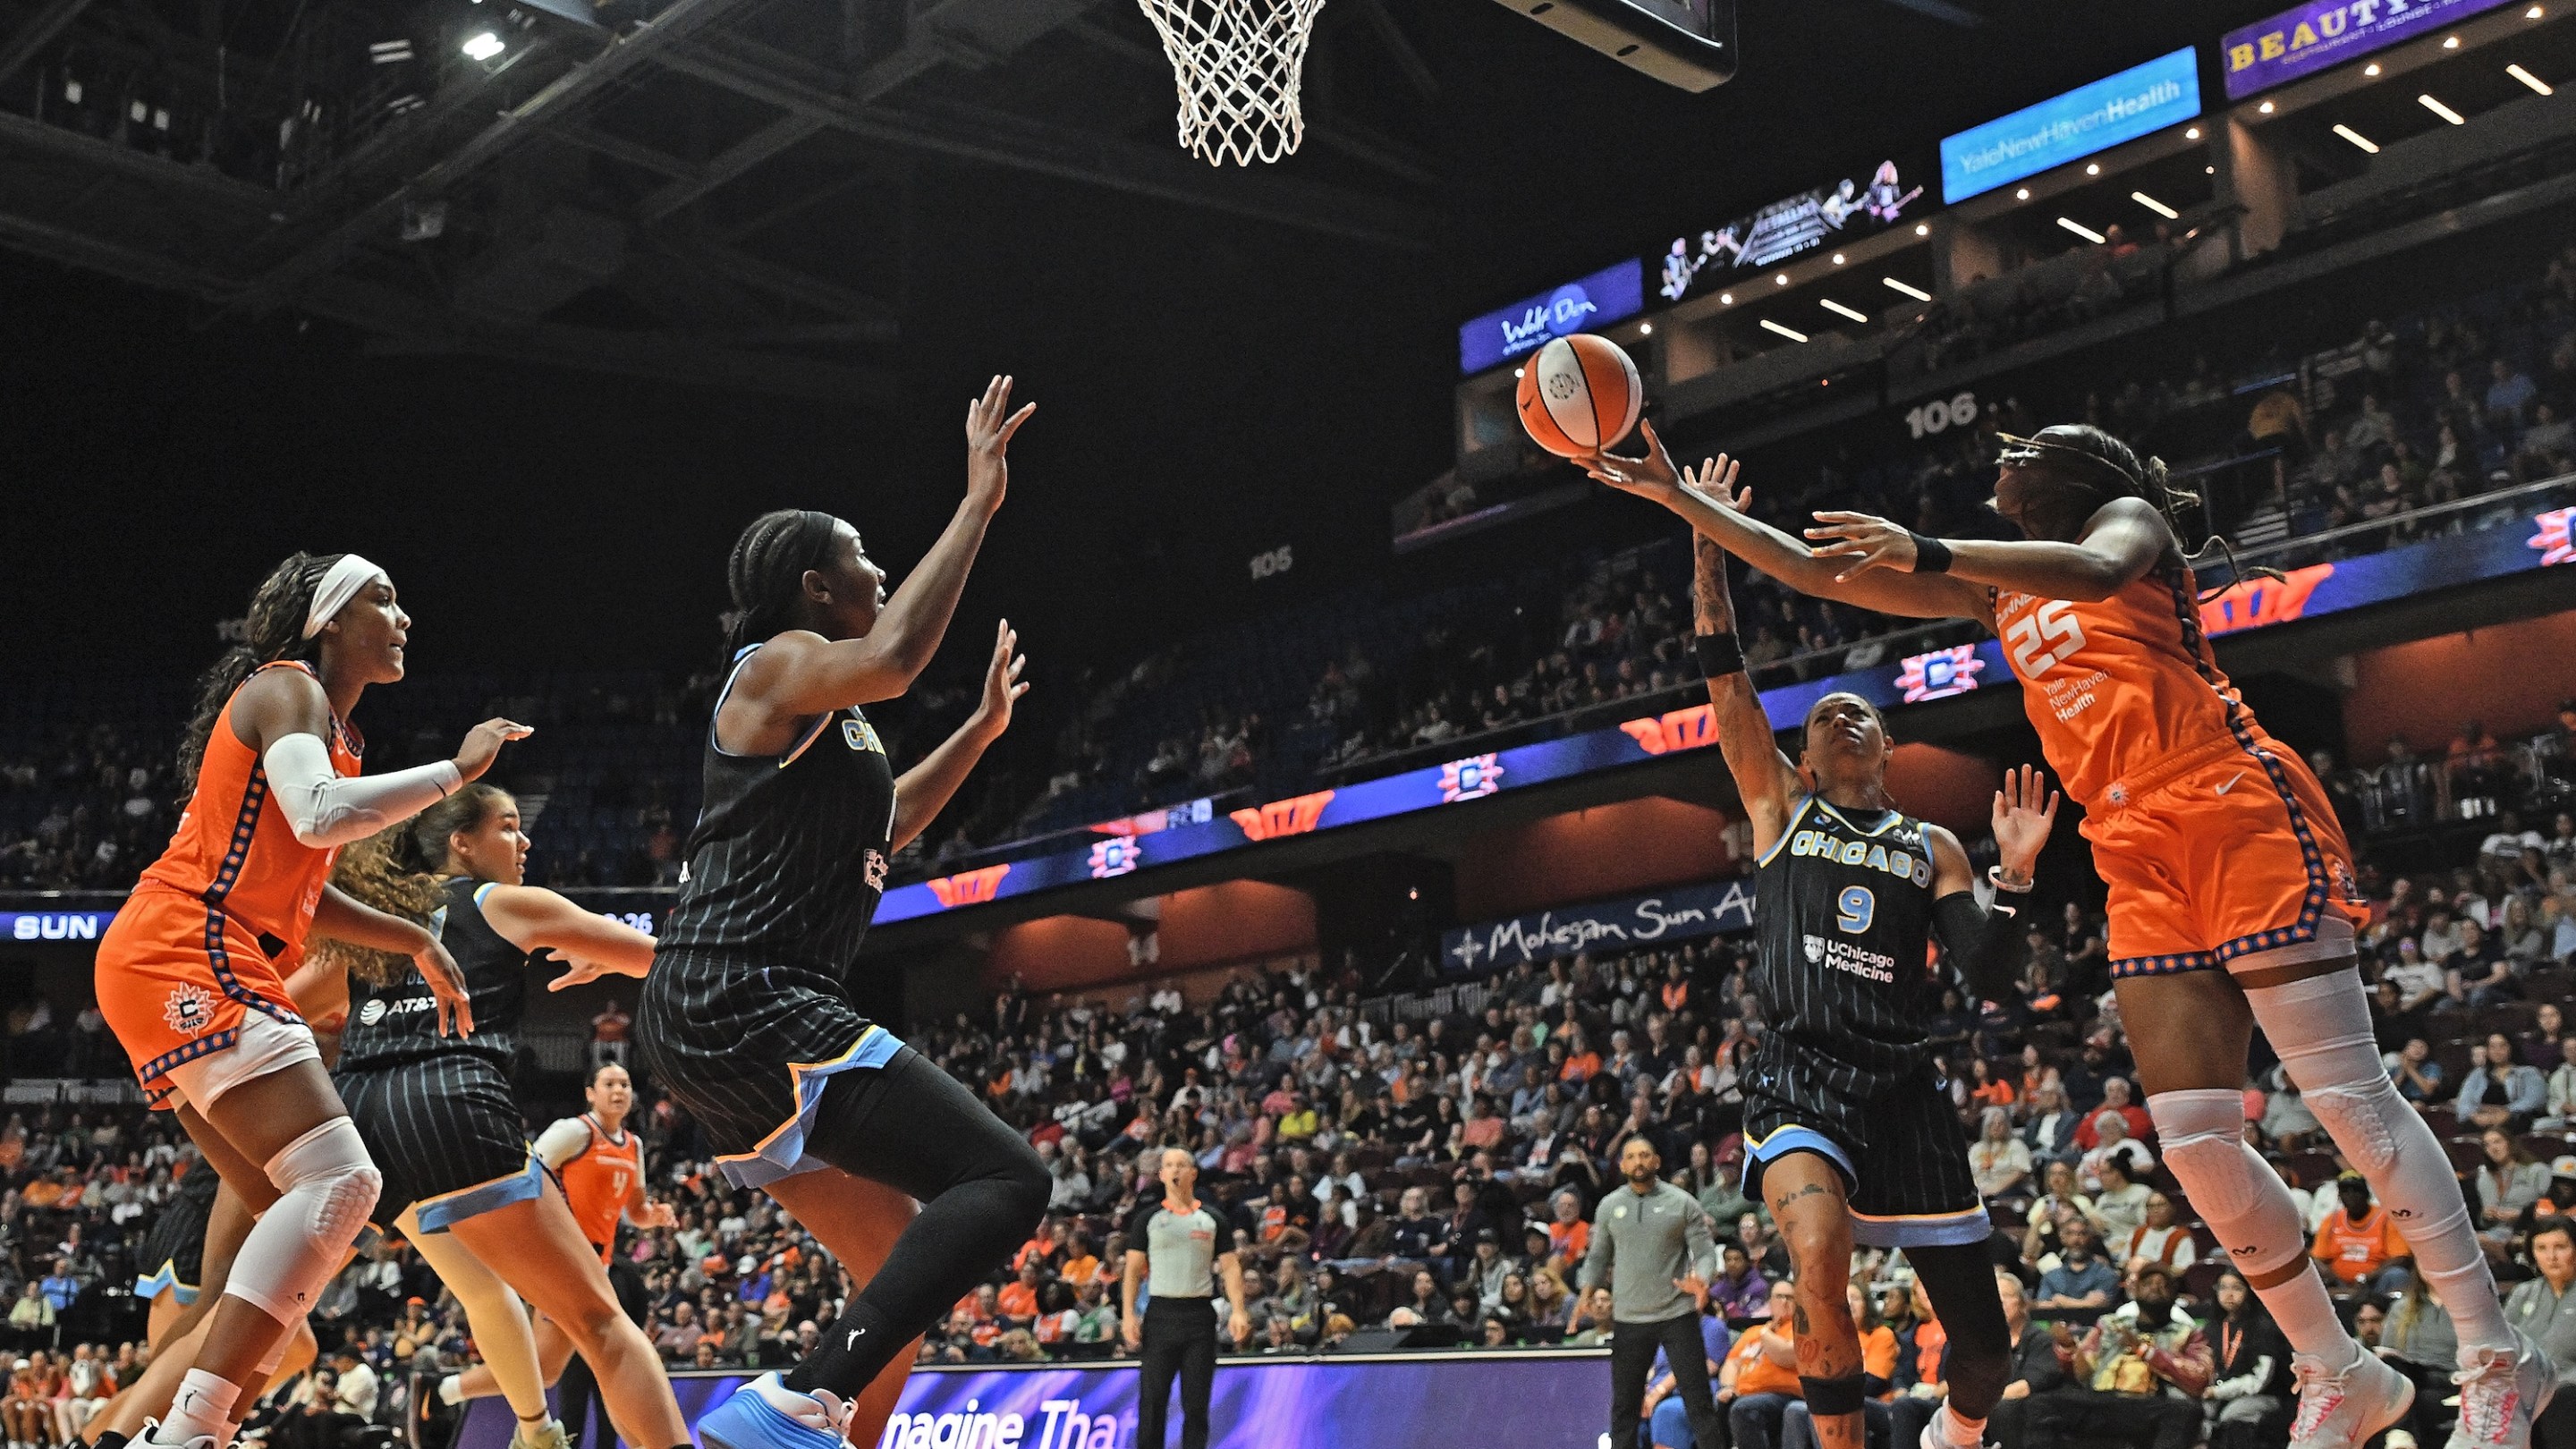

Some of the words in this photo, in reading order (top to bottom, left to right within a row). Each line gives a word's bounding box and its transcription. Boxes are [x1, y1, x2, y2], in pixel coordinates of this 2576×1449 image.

[2229, 0, 2408, 72] BEAUTY
[1906, 394, 1977, 439] 106
[1250, 546, 1292, 580] 105
[2006, 599, 2087, 680] 25
[2043, 677, 2066, 697] Yale
[2049, 669, 2112, 710] NewHaven
[2055, 691, 2096, 724] Health
[1791, 829, 1930, 889] CHICAGO
[13, 915, 97, 939] SUN
[1488, 911, 1628, 962] Mohegan
[1632, 899, 1706, 939] Sun
[1836, 886, 1875, 934] 9
[1825, 953, 1894, 983] Medicine
[1826, 939, 1894, 968] UChicago
[880, 1398, 1025, 1449] magine
